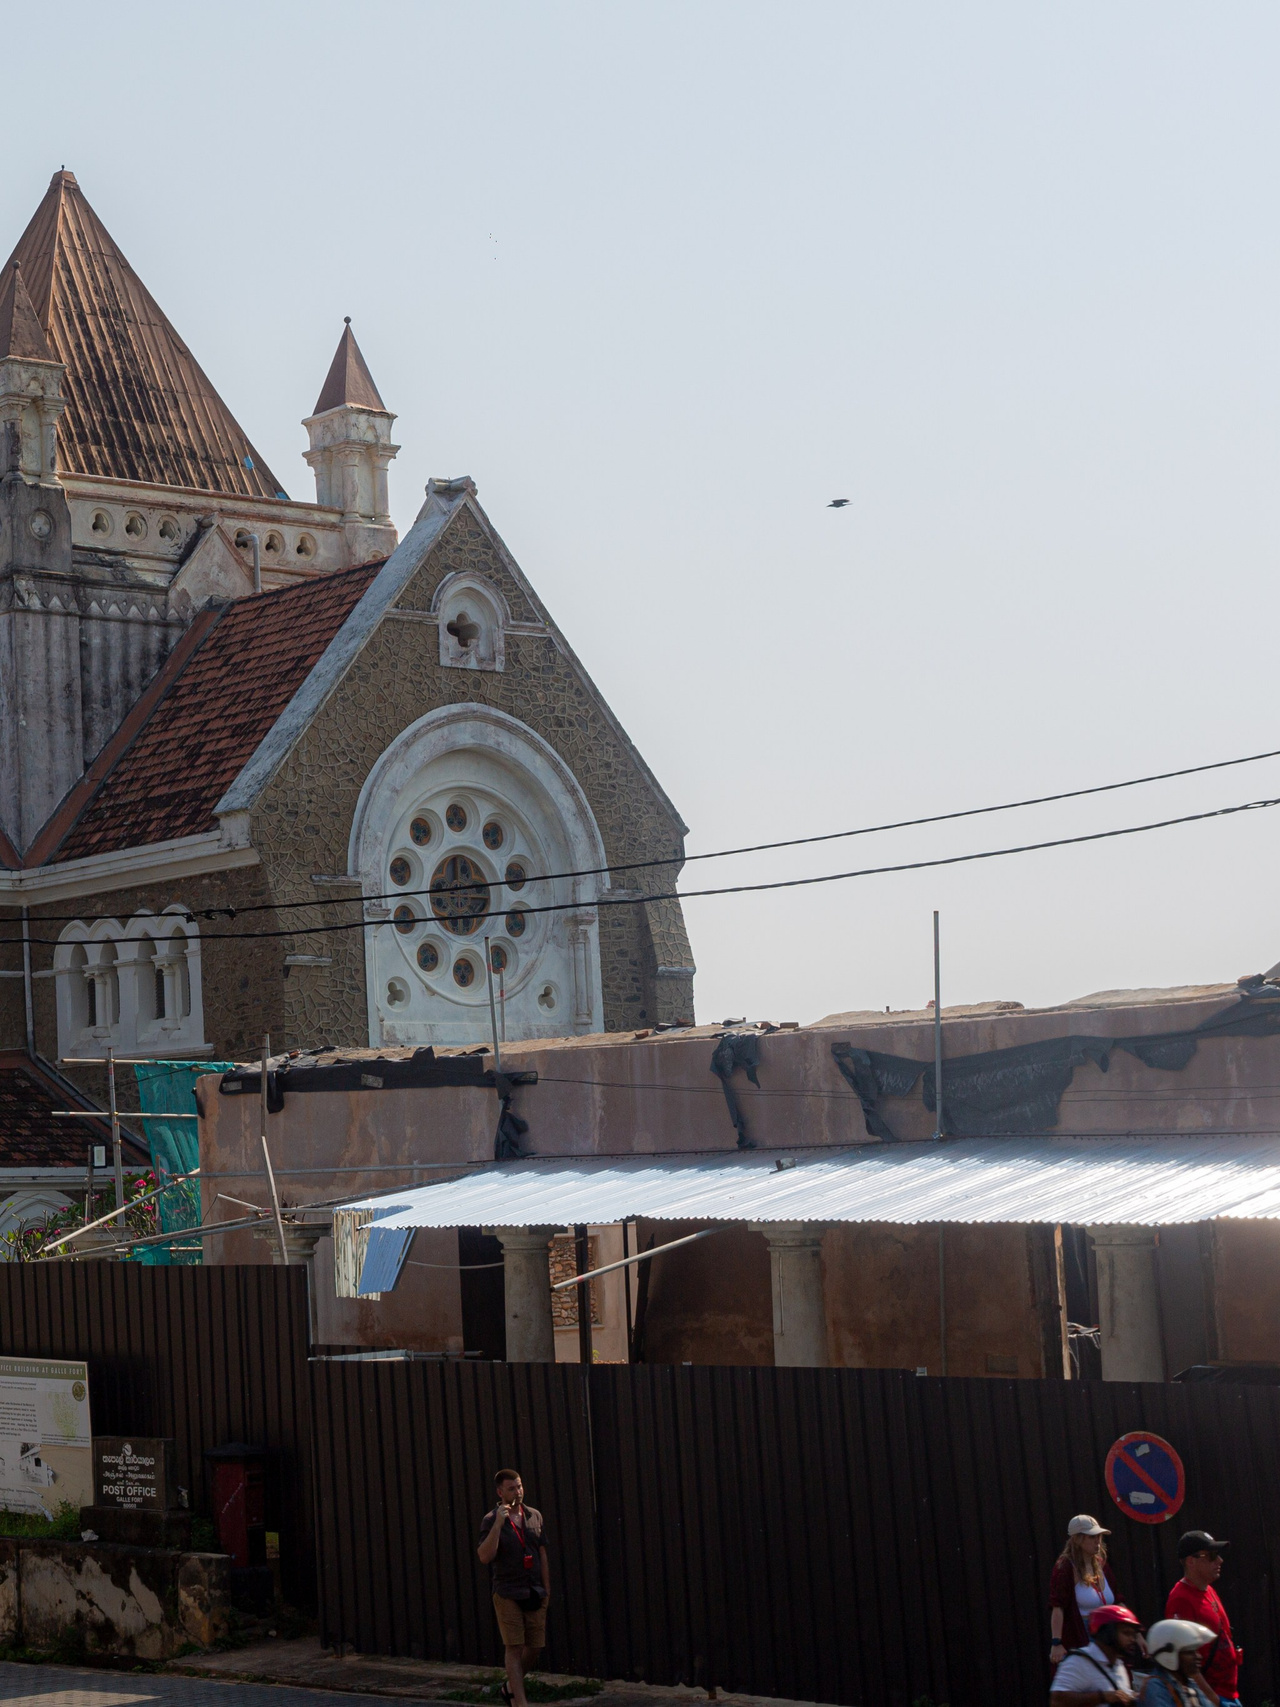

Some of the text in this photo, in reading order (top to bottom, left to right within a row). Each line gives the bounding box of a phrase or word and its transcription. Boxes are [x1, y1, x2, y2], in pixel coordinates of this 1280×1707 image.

[14, 1365, 39, 1373] BUILDING
[102, 1485, 156, 1497] POST OFFICE
